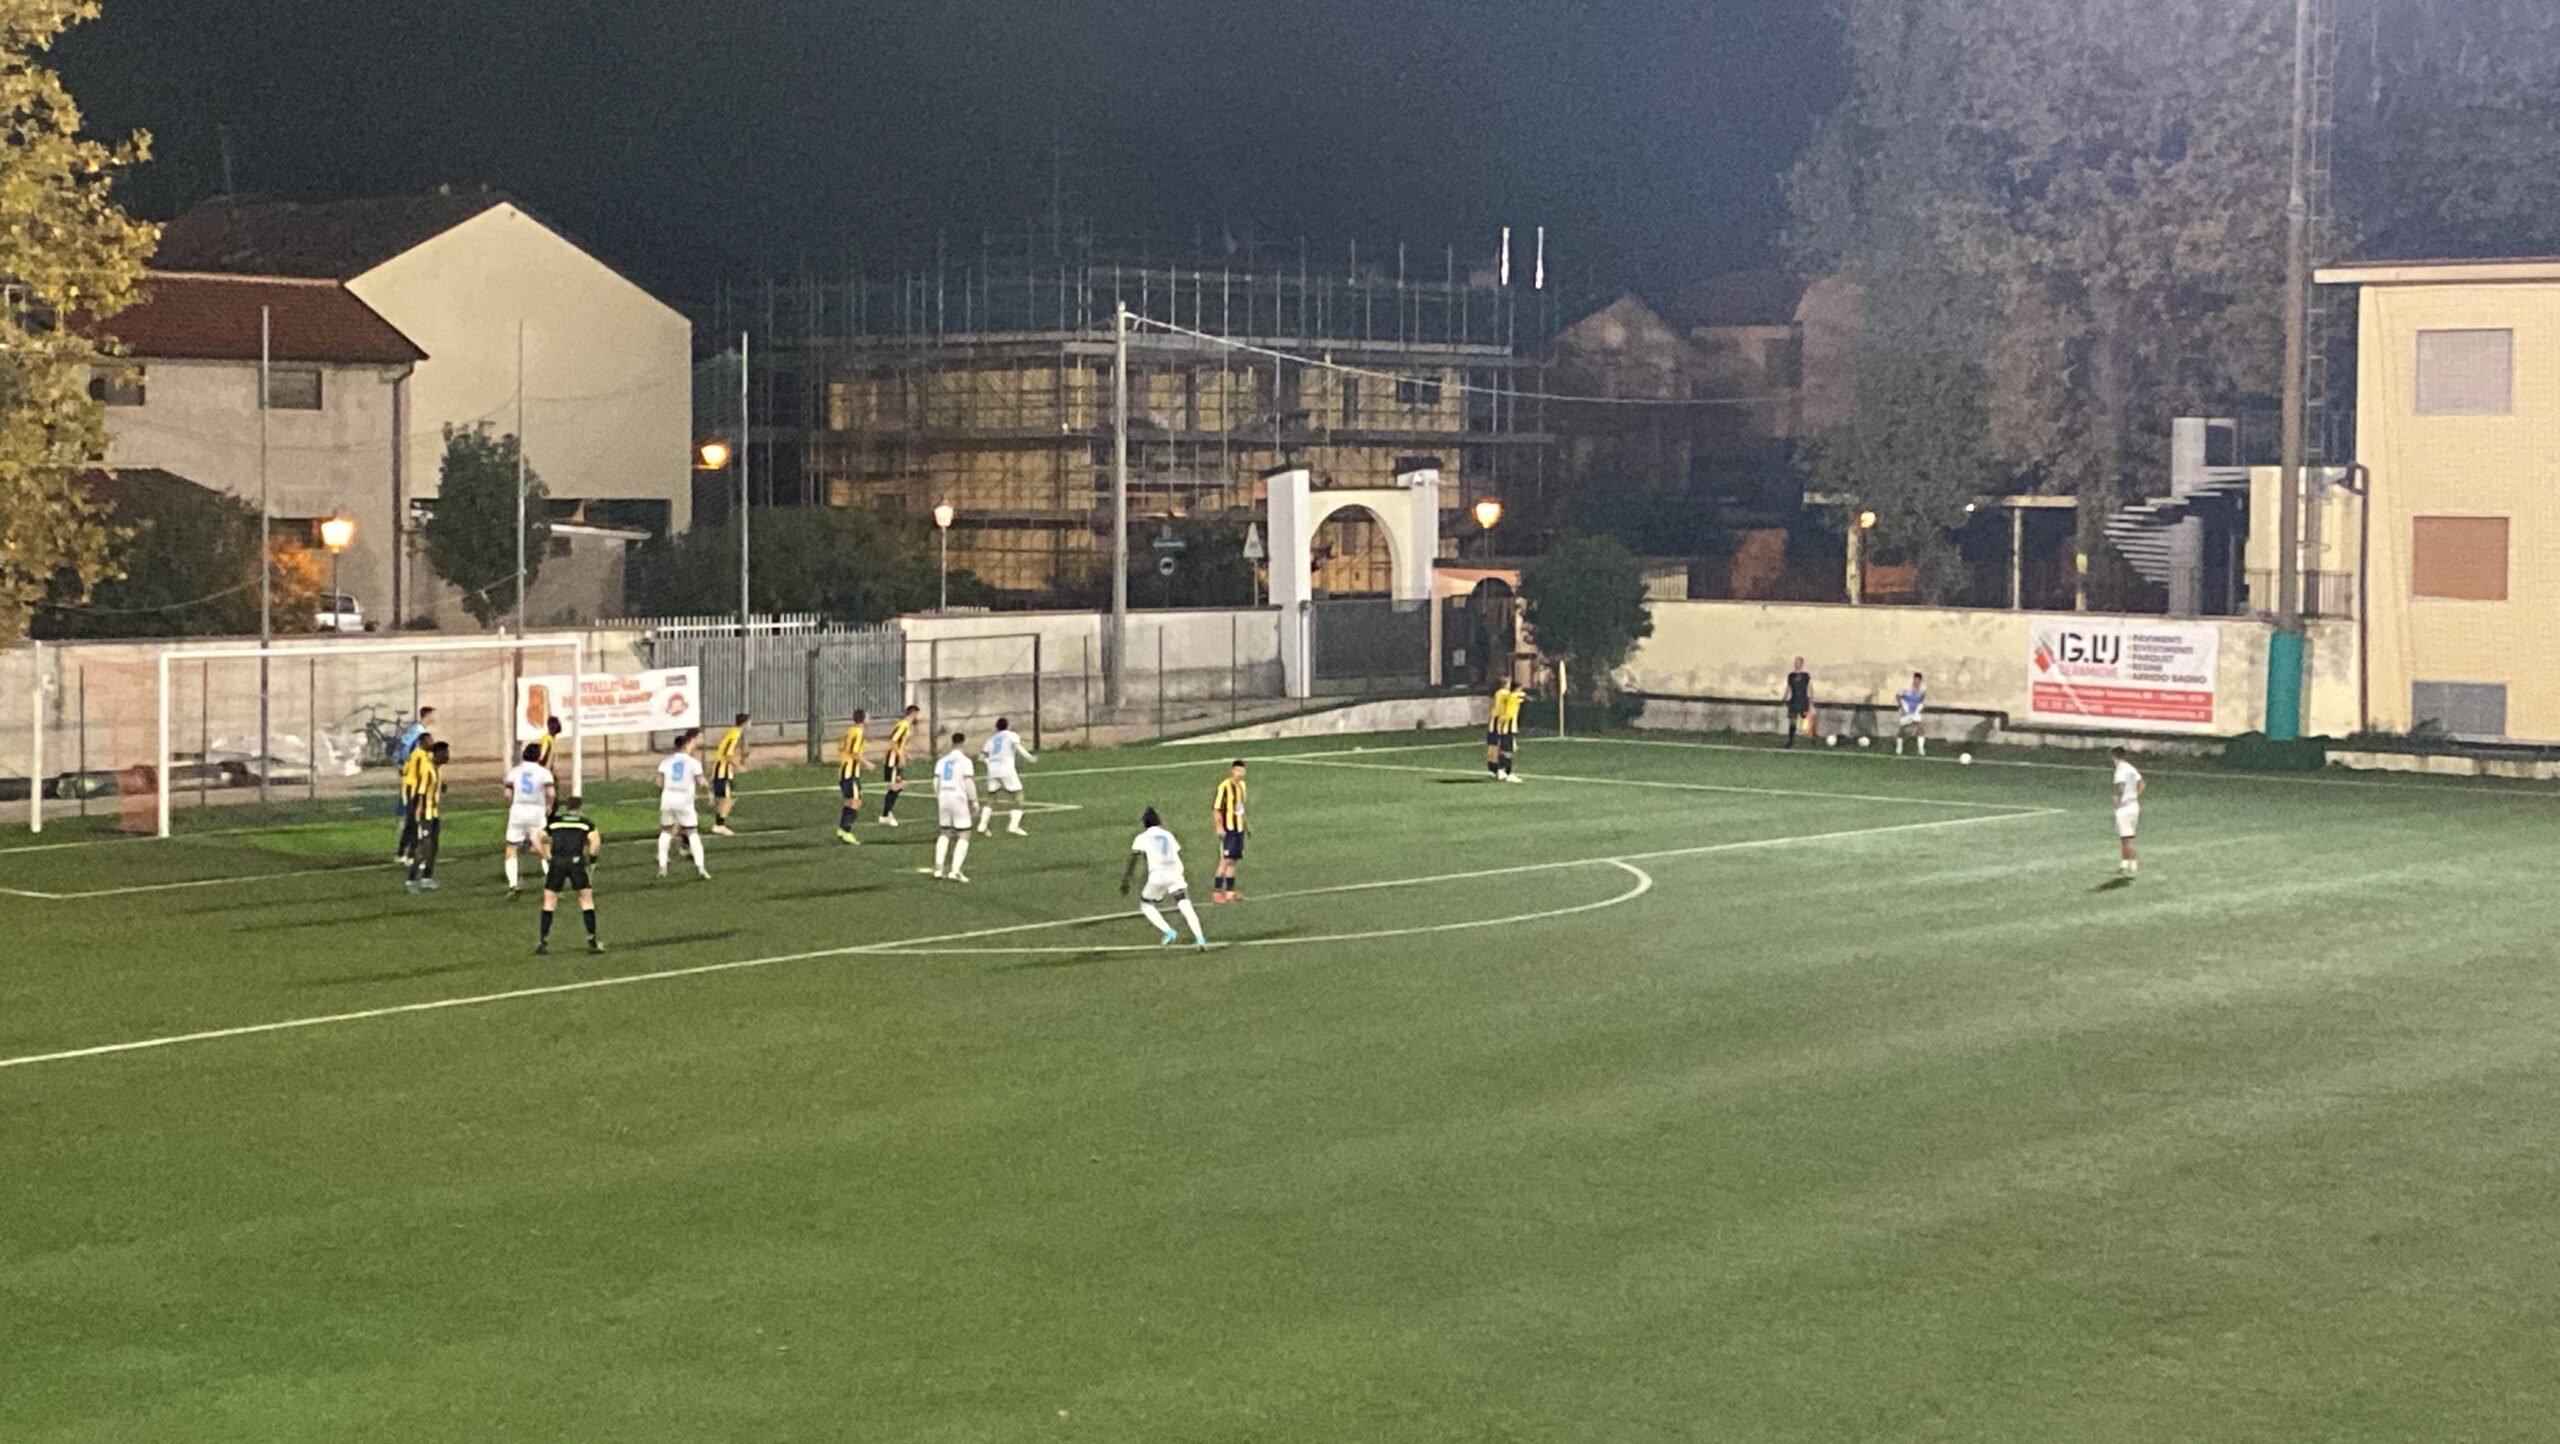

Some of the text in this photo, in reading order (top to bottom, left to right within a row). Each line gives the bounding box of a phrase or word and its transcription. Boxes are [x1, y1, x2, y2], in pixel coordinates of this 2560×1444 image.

[672, 761, 686, 782] 9
[944, 759, 956, 781] 6
[521, 771, 534, 795] 5
[1154, 836, 1169, 857] 7
